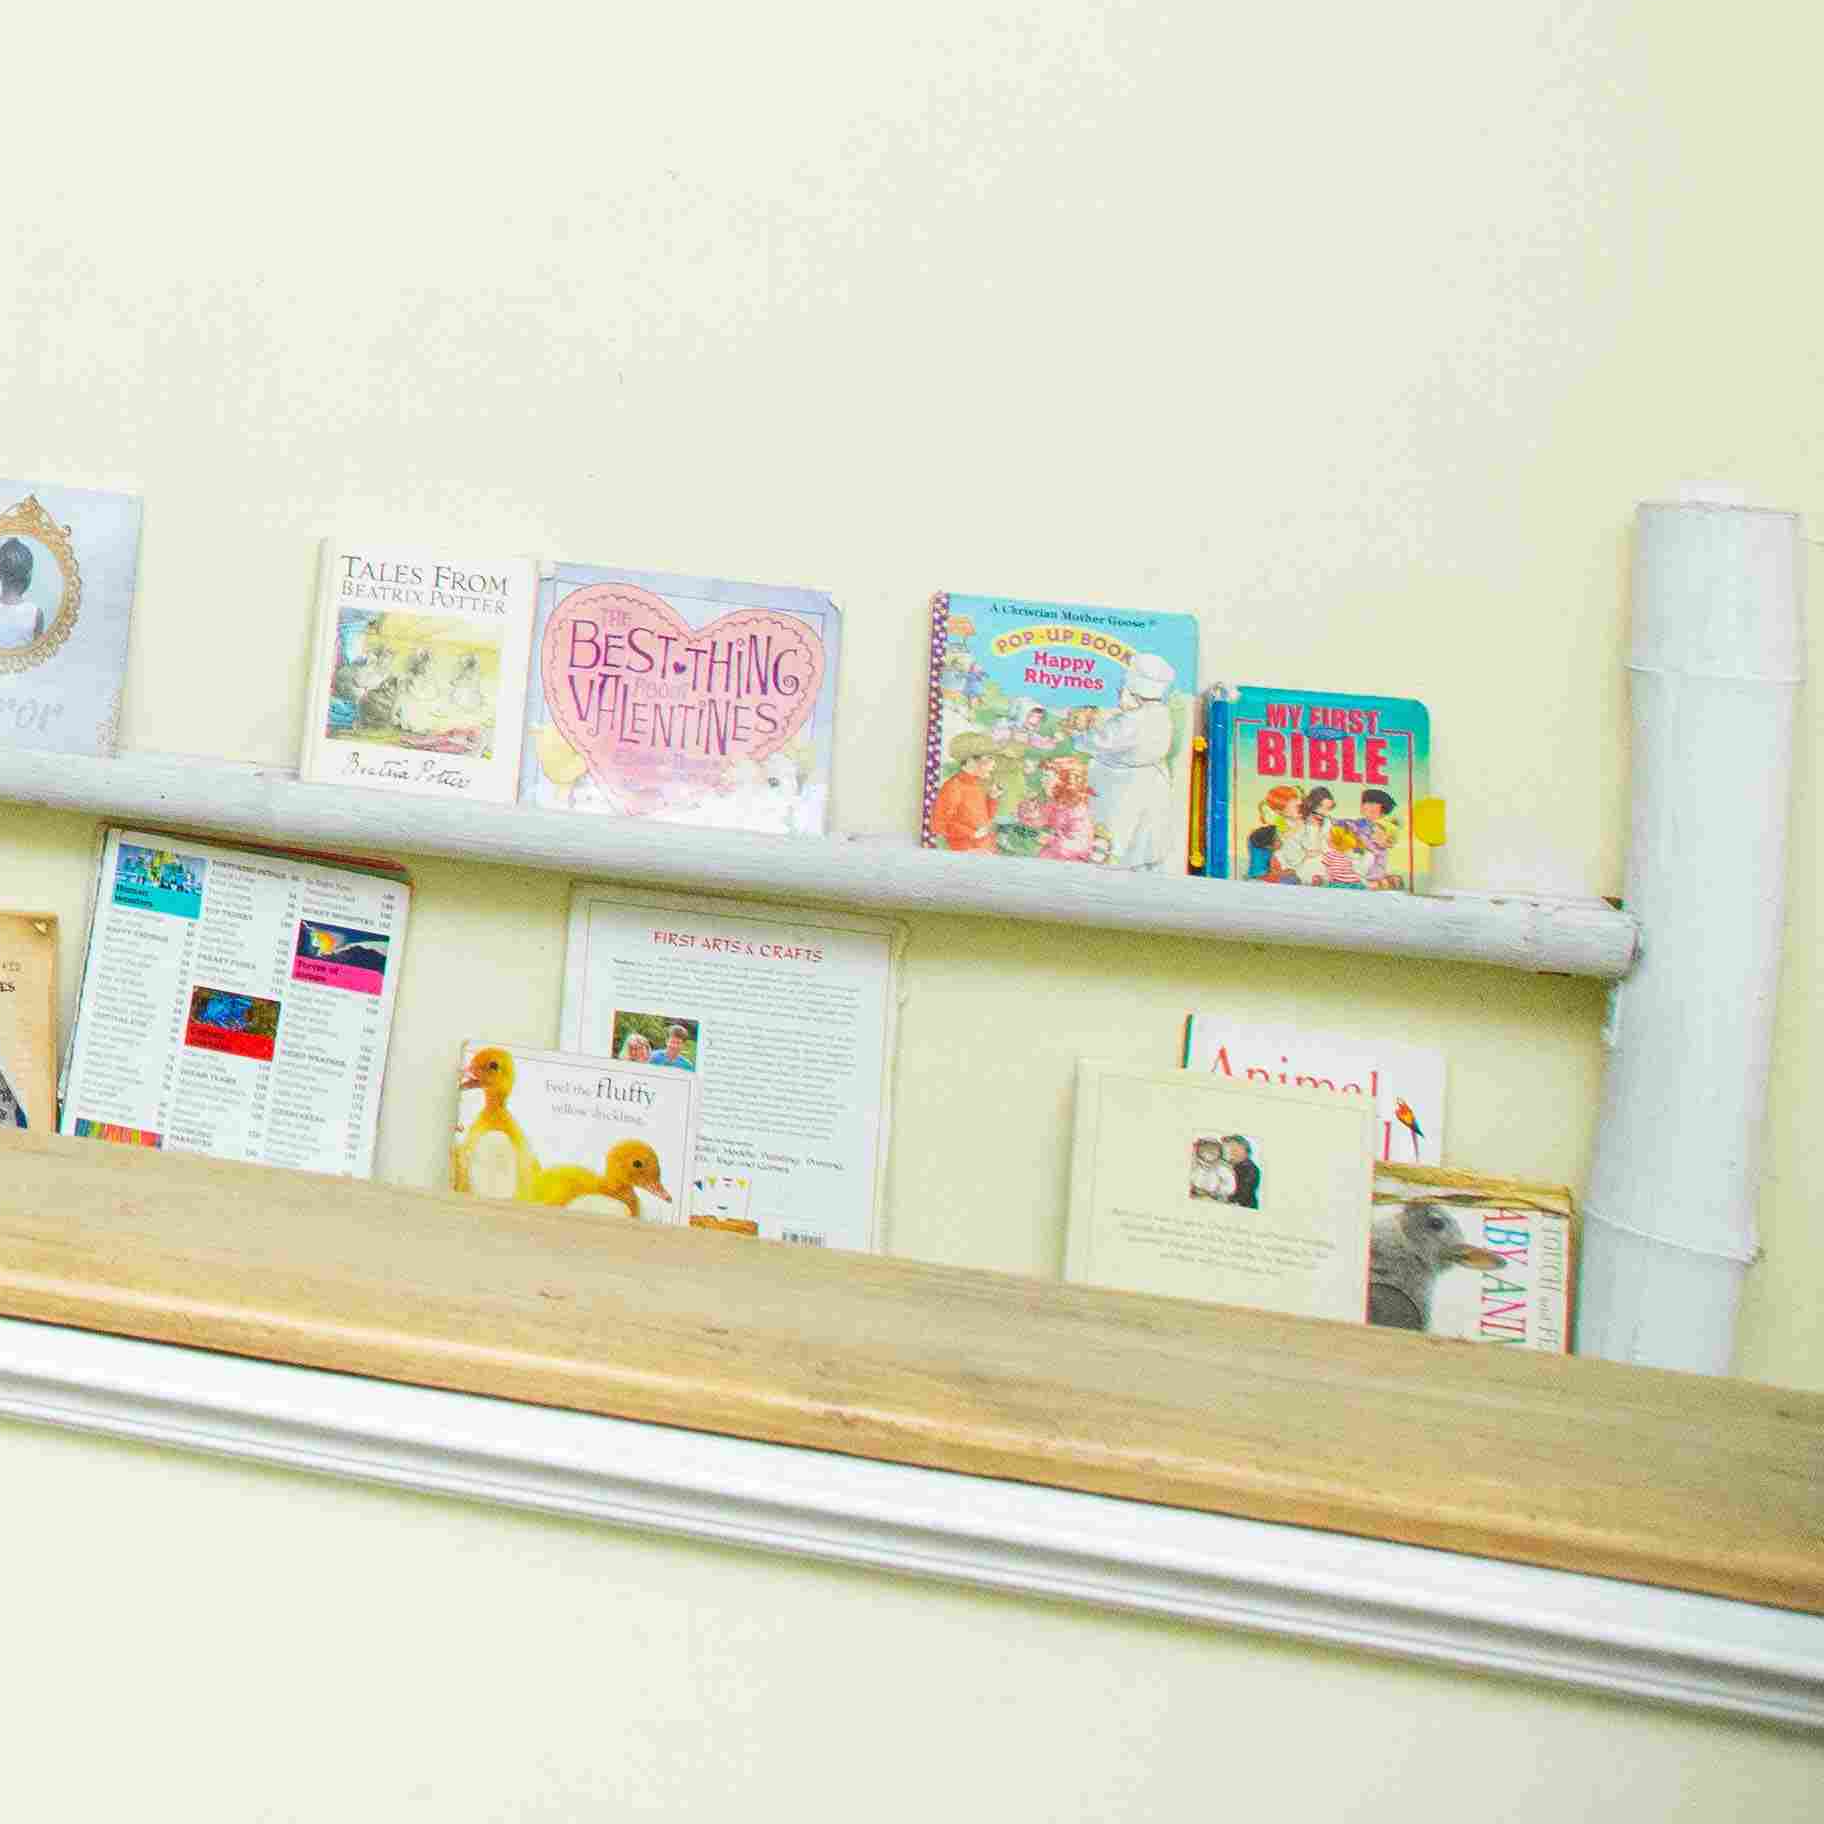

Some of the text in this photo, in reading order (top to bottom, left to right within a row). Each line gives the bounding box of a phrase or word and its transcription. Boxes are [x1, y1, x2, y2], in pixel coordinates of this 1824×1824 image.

[341, 555, 510, 596] TALES FROM
[340, 578, 507, 616] BEATRIX POTTER
[1062, 609, 1106, 625] Mother
[1108, 615, 1145, 630] Goose
[1034, 649, 1096, 675] Happy
[1080, 632, 1134, 666] BOOK
[1024, 668, 1105, 693] Rhymes
[1266, 703, 1380, 736] MY FIRST
[1257, 729, 1390, 785] BIBLE
[652, 930, 698, 948] FIRST
[703, 935, 742, 954] ARTS
[759, 944, 825, 964] CRAFTS
[545, 1076, 656, 1110] Feel the fluffy
[1483, 1207, 1530, 1267] ABY
